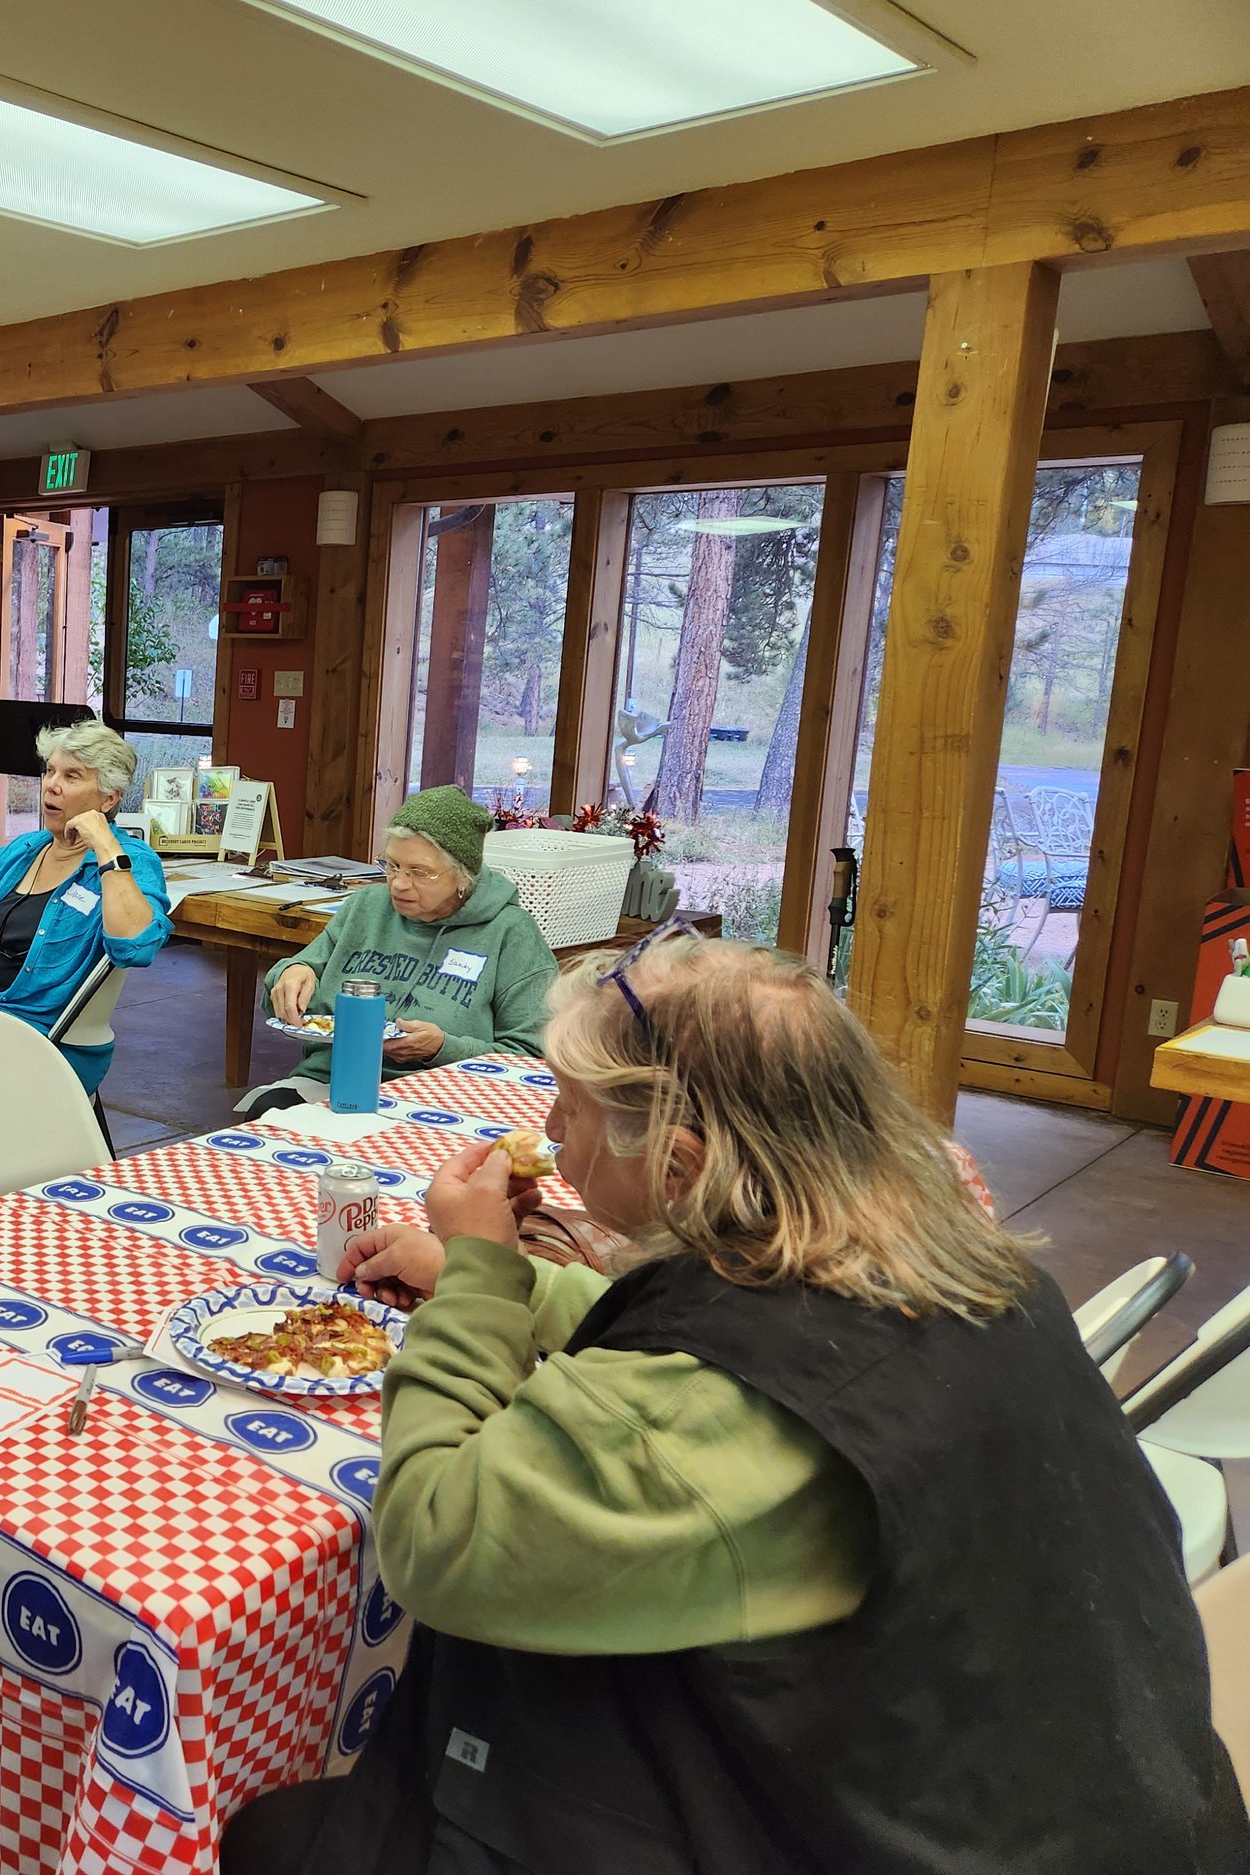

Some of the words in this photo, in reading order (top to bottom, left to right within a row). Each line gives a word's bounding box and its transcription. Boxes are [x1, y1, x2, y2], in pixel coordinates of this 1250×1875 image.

[46, 453, 78, 489] EXIT
[241, 673, 255, 685] FIRE
[341, 950, 420, 983] CRESTED
[416, 962, 478, 1009] BUTTE
[469, 1064, 497, 1072] EAT
[420, 1113, 450, 1123] EAT
[220, 1137, 251, 1147] EAT
[286, 1153, 318, 1166] EAT
[57, 1184, 89, 1198] EAT
[124, 1205, 158, 1219] EAT
[339, 1202, 377, 1232] Pepp
[195, 1229, 232, 1245] EAT
[272, 1254, 311, 1273] EAT
[66, 1339, 95, 1353] EA
[151, 1377, 197, 1398] EAT
[245, 1417, 295, 1444] EAT
[19, 1605, 61, 1647] EAT
[111, 1680, 152, 1726] AT
[357, 1690, 379, 1733] EAT
